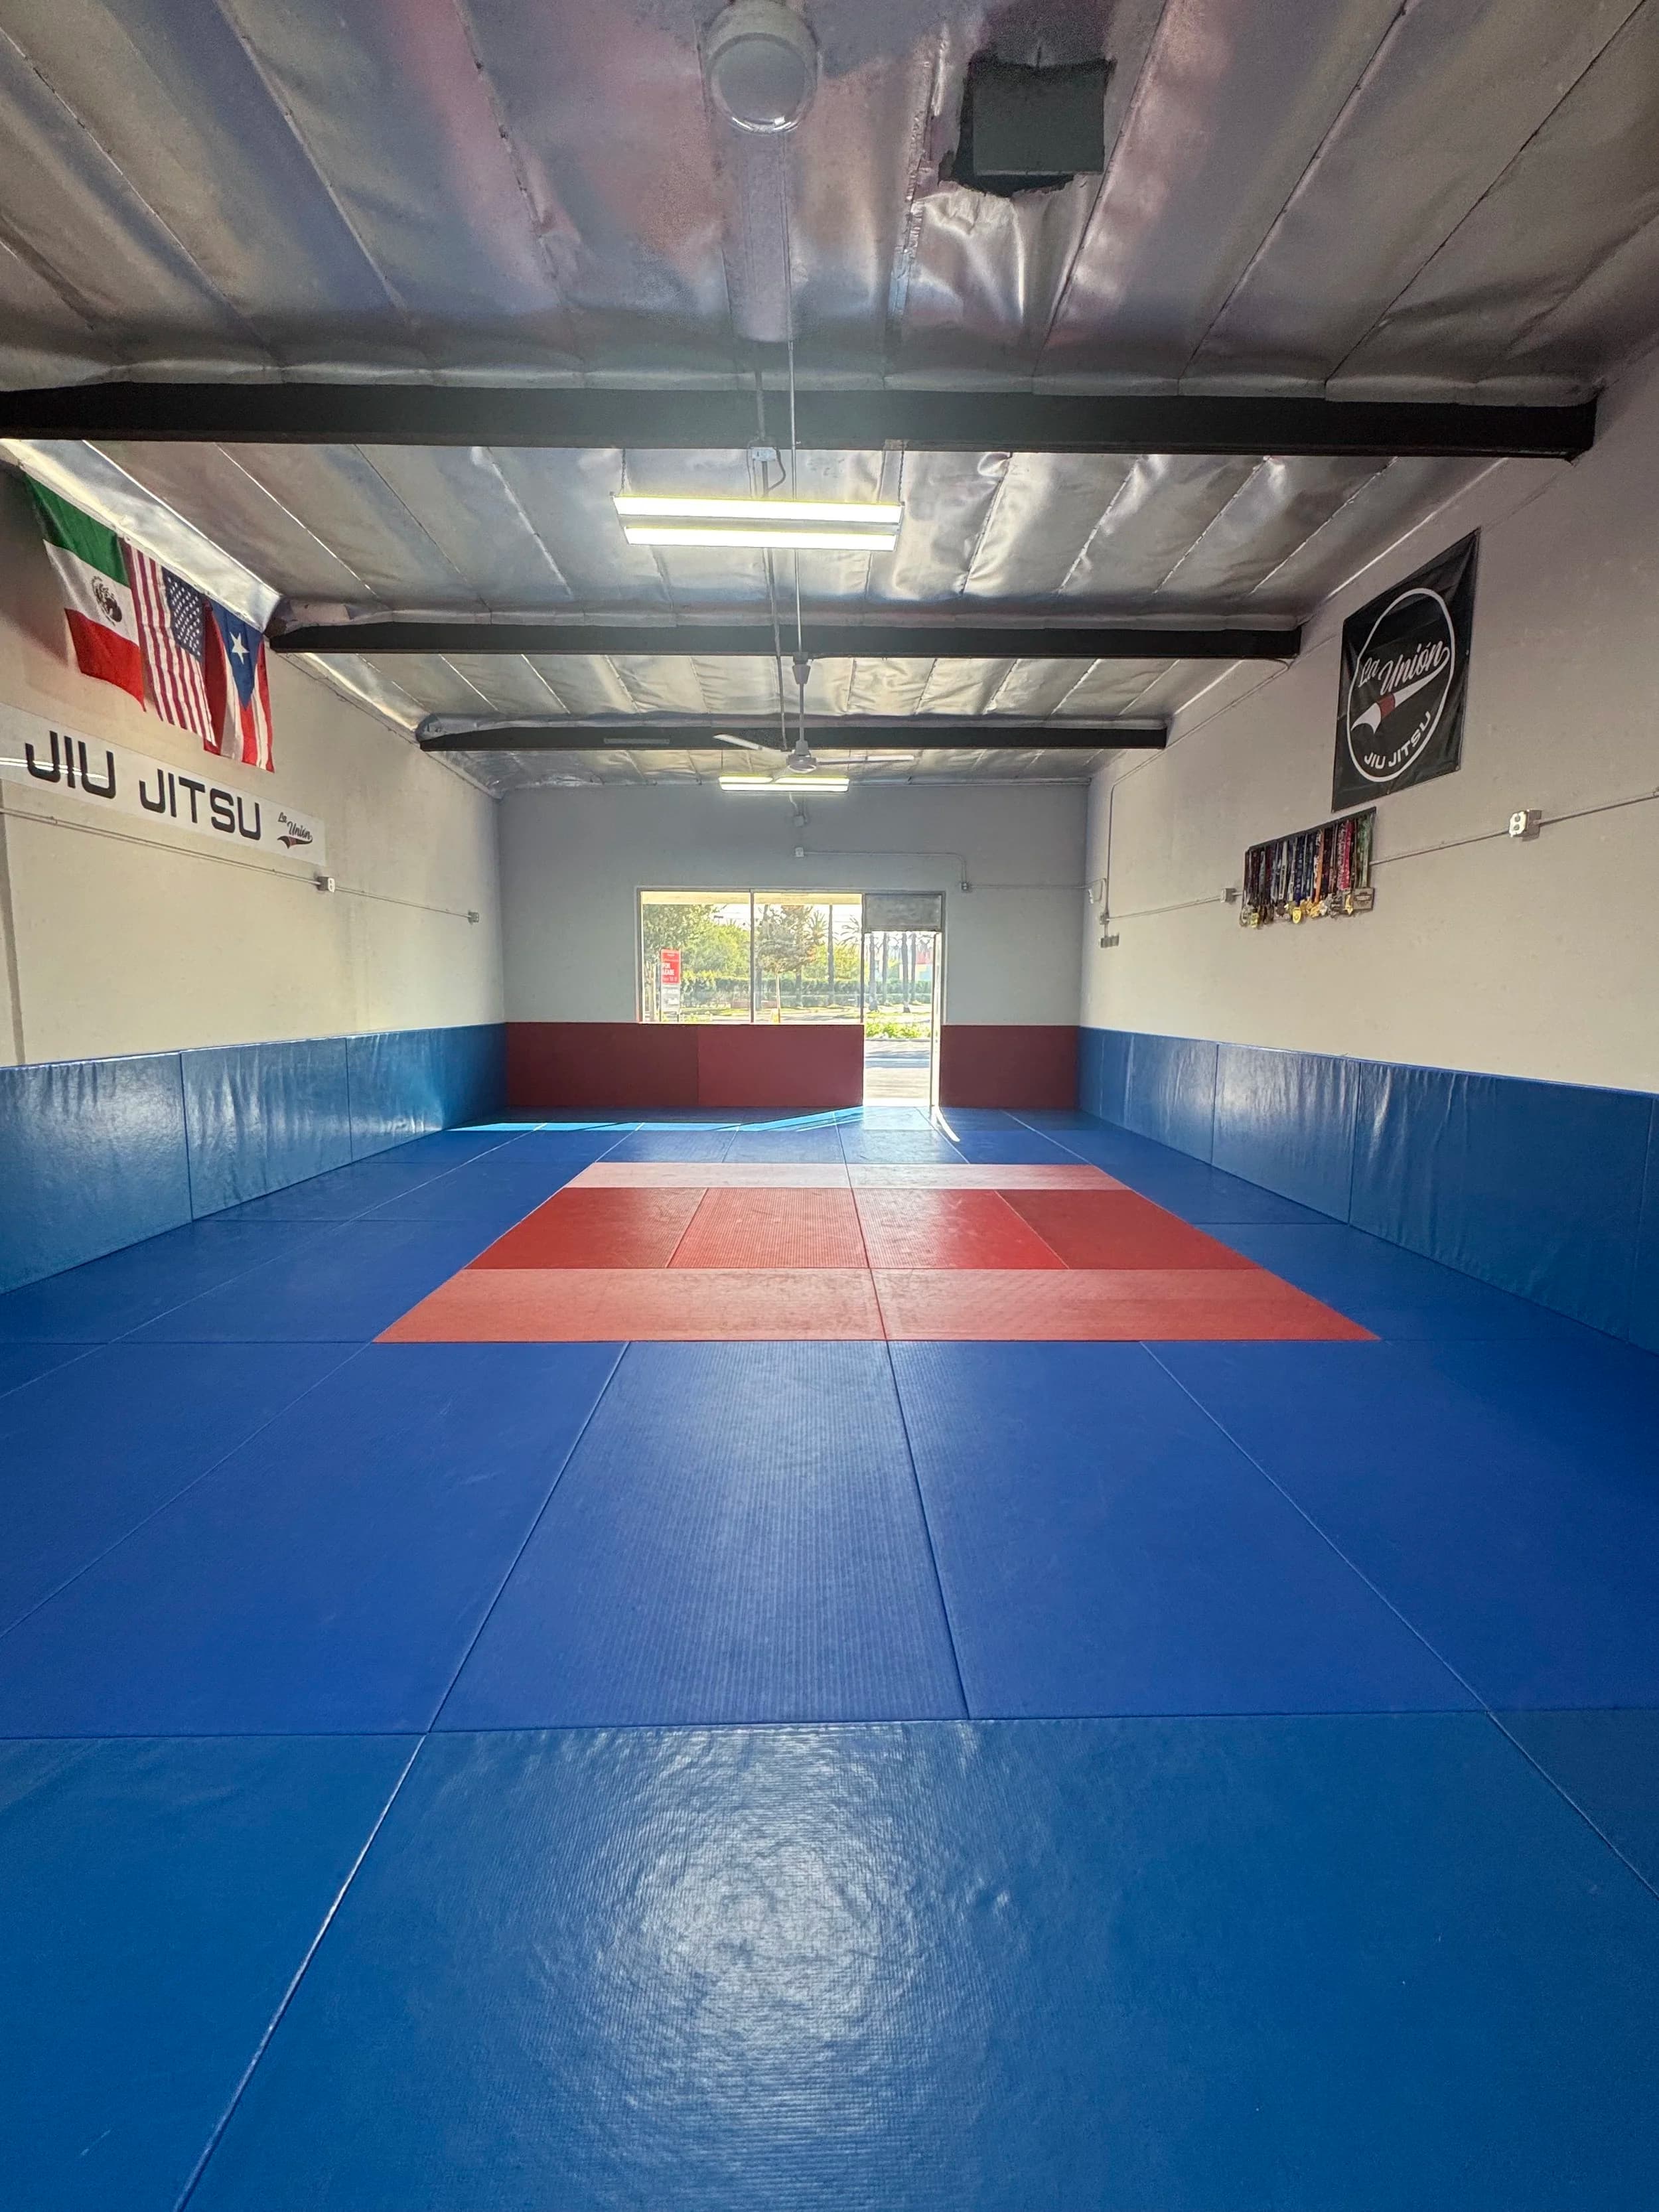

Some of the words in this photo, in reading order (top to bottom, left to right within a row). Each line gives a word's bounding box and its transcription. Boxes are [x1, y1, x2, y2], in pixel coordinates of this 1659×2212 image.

[1358, 657, 1380, 688] La
[1378, 640, 1445, 696] Unión
[1364, 752, 1386, 769] JIU
[1388, 711, 1431, 767] JITSU
[25, 731, 116, 799] JIU
[139, 769, 261, 840] JITSU
[277, 812, 287, 823] La
